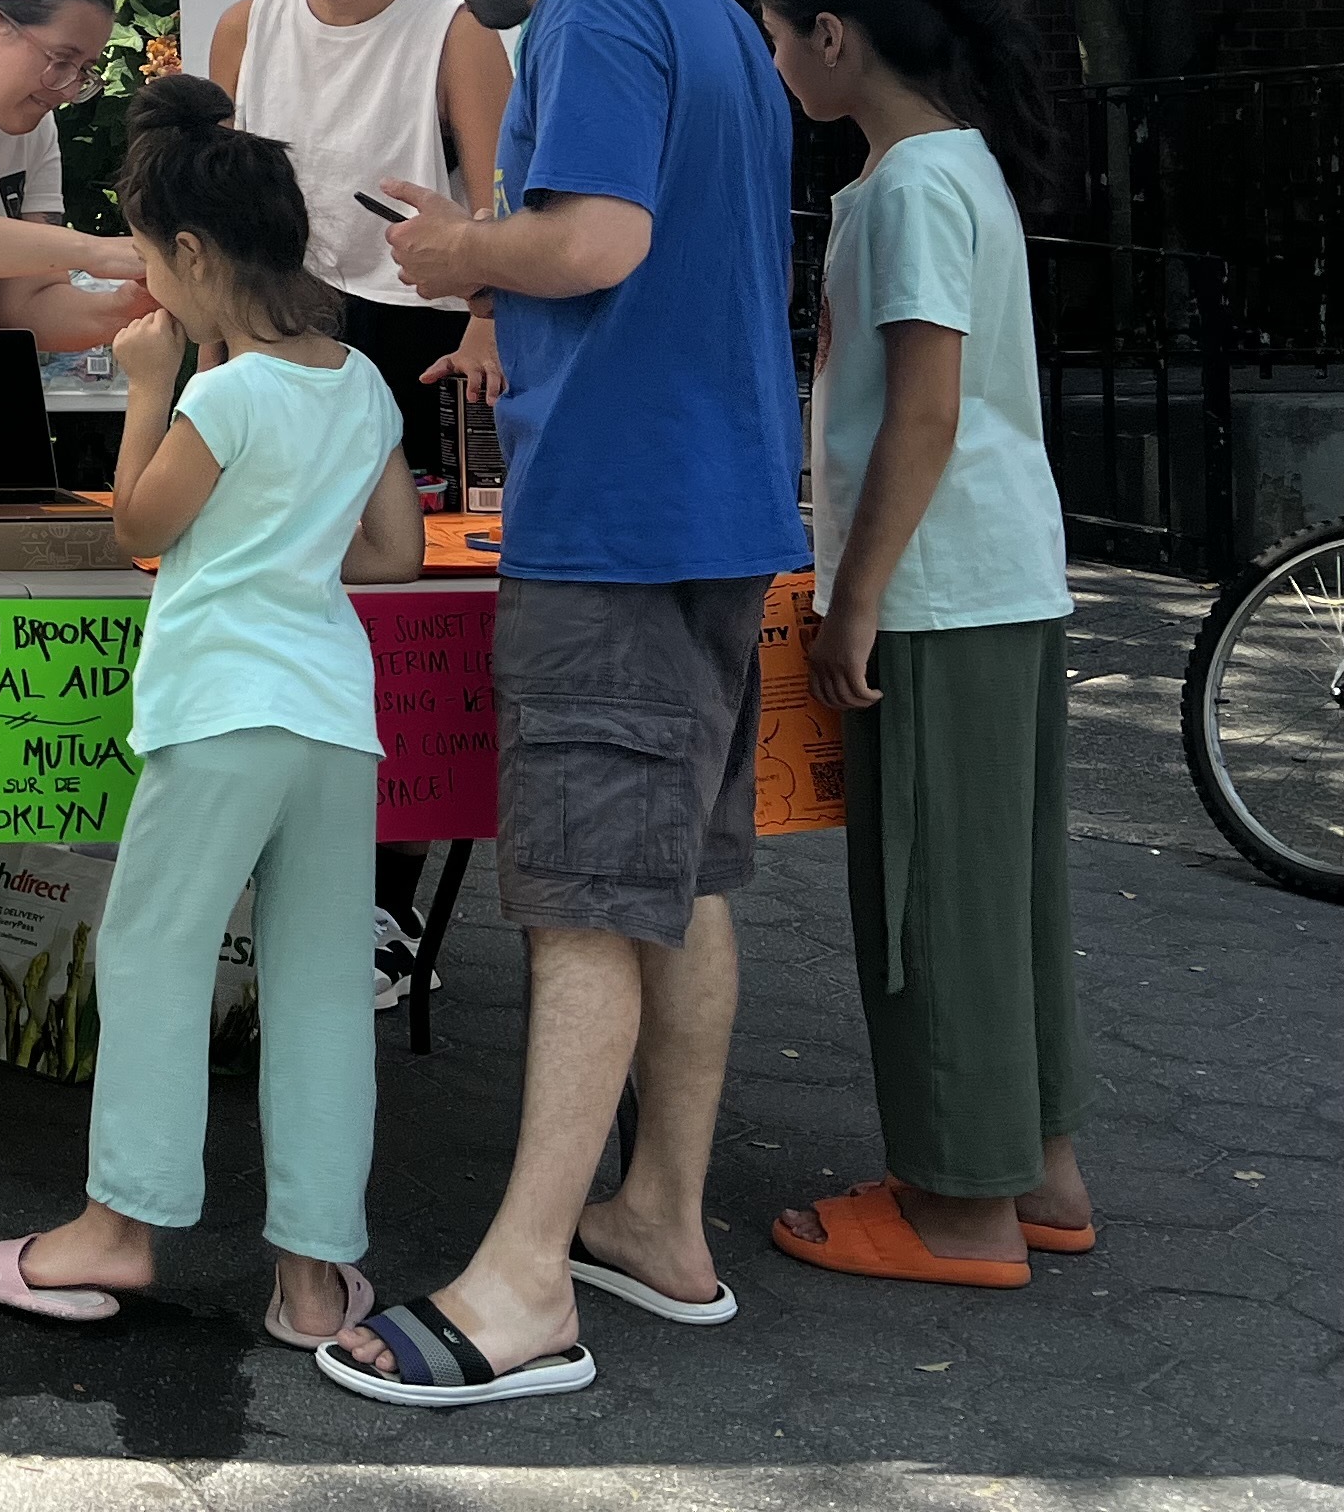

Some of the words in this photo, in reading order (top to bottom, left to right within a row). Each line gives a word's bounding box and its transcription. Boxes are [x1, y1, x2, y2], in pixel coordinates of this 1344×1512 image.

[394, 610, 472, 643] SUNSET
[375, 650, 450, 676] TERIM
[58, 666, 130, 699] AID
[375, 690, 436, 713] SING
[23, 734, 136, 776] MUTUA
[396, 732, 408, 757] A
[2, 776, 44, 794] SUR
[54, 776, 81, 793] DE
